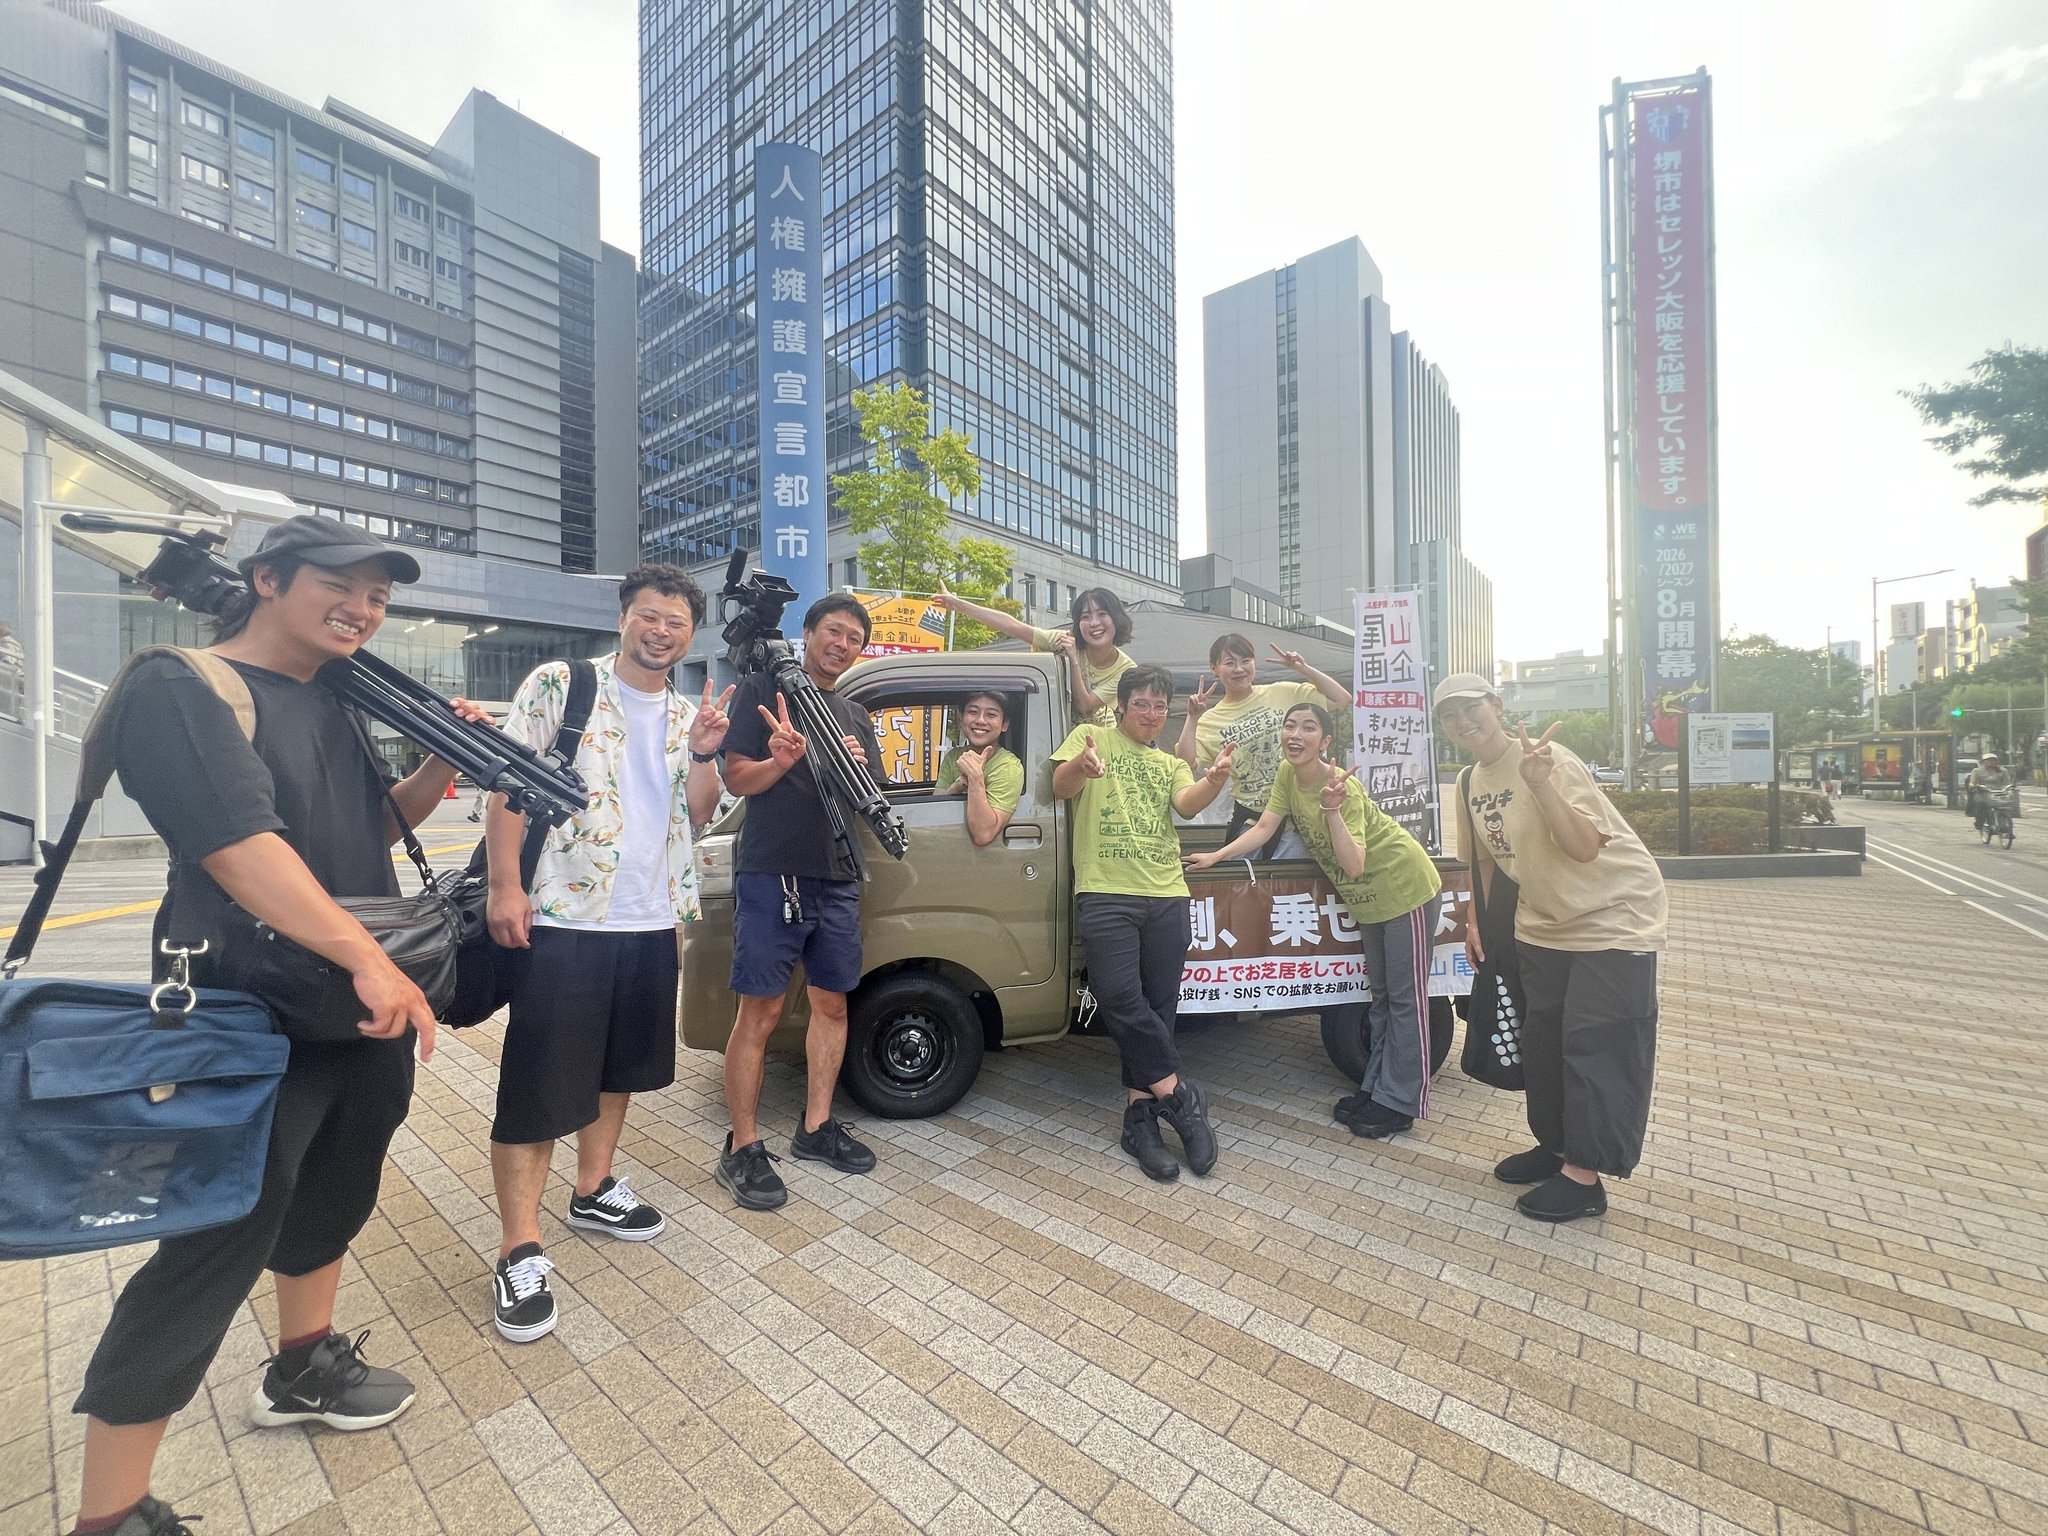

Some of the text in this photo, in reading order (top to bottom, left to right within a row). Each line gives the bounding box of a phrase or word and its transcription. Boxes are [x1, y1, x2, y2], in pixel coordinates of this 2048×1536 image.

[1652, 150, 1687, 505] 堺市はセレッソ大阪を応援しています。
[770, 165, 809, 559] 人権擁護宣言都市
[1656, 548, 1686, 562] 2026
[1658, 562, 1694, 576] /2027
[1656, 577, 1695, 588] シーズン
[1656, 588, 1696, 618] 8月
[1656, 620, 1697, 679] 開幕
[1219, 711, 1272, 739] WELCOME
[1110, 752, 1161, 776] WELCOME
[1471, 788, 1514, 813] ゲンキ
